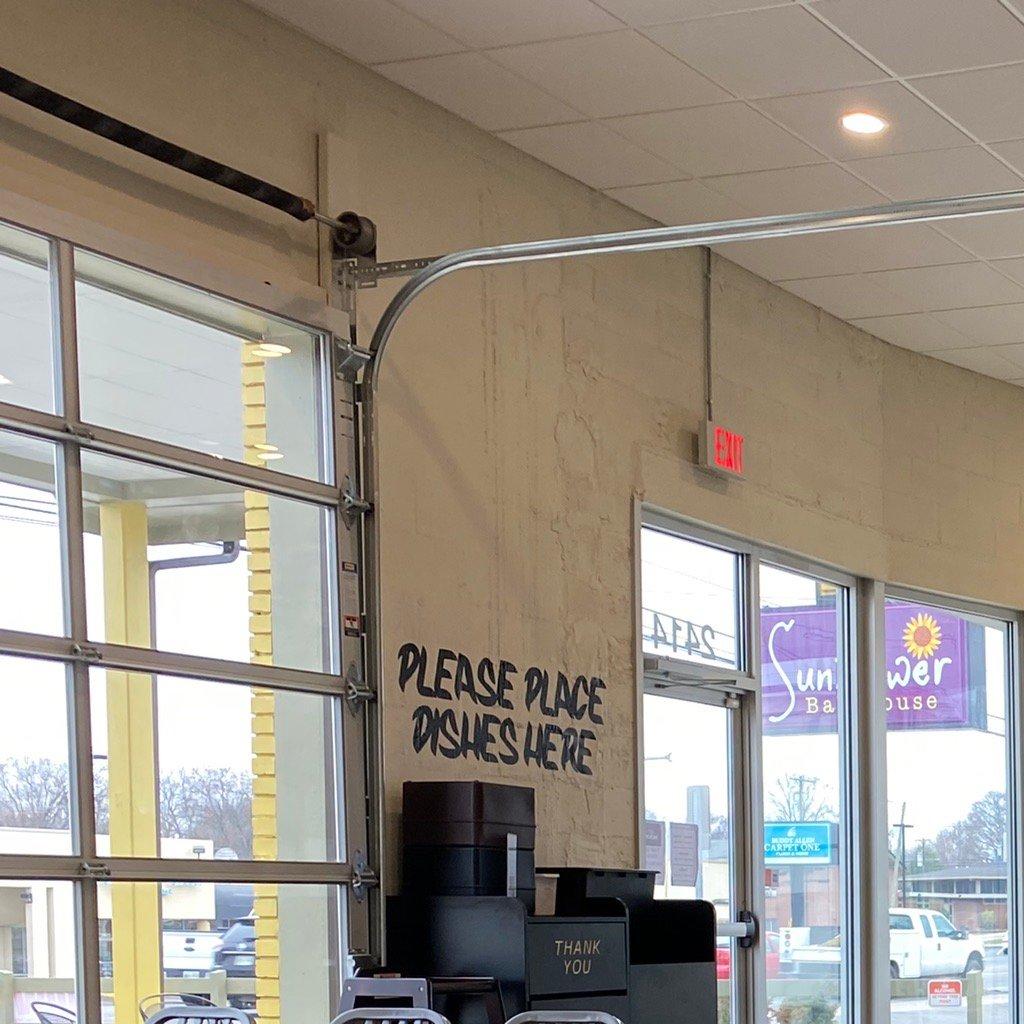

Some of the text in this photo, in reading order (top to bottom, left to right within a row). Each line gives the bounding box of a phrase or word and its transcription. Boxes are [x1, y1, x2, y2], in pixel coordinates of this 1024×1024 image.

[714, 426, 745, 475] EXIT
[397, 642, 607, 725] PLEASE PLACE
[768, 618, 952, 723] Sunwer
[411, 704, 597, 776] DISHES HERE
[764, 843, 821, 852] CARPET ONE
[555, 939, 601, 956] THANK
[564, 959, 591, 975] YOU
